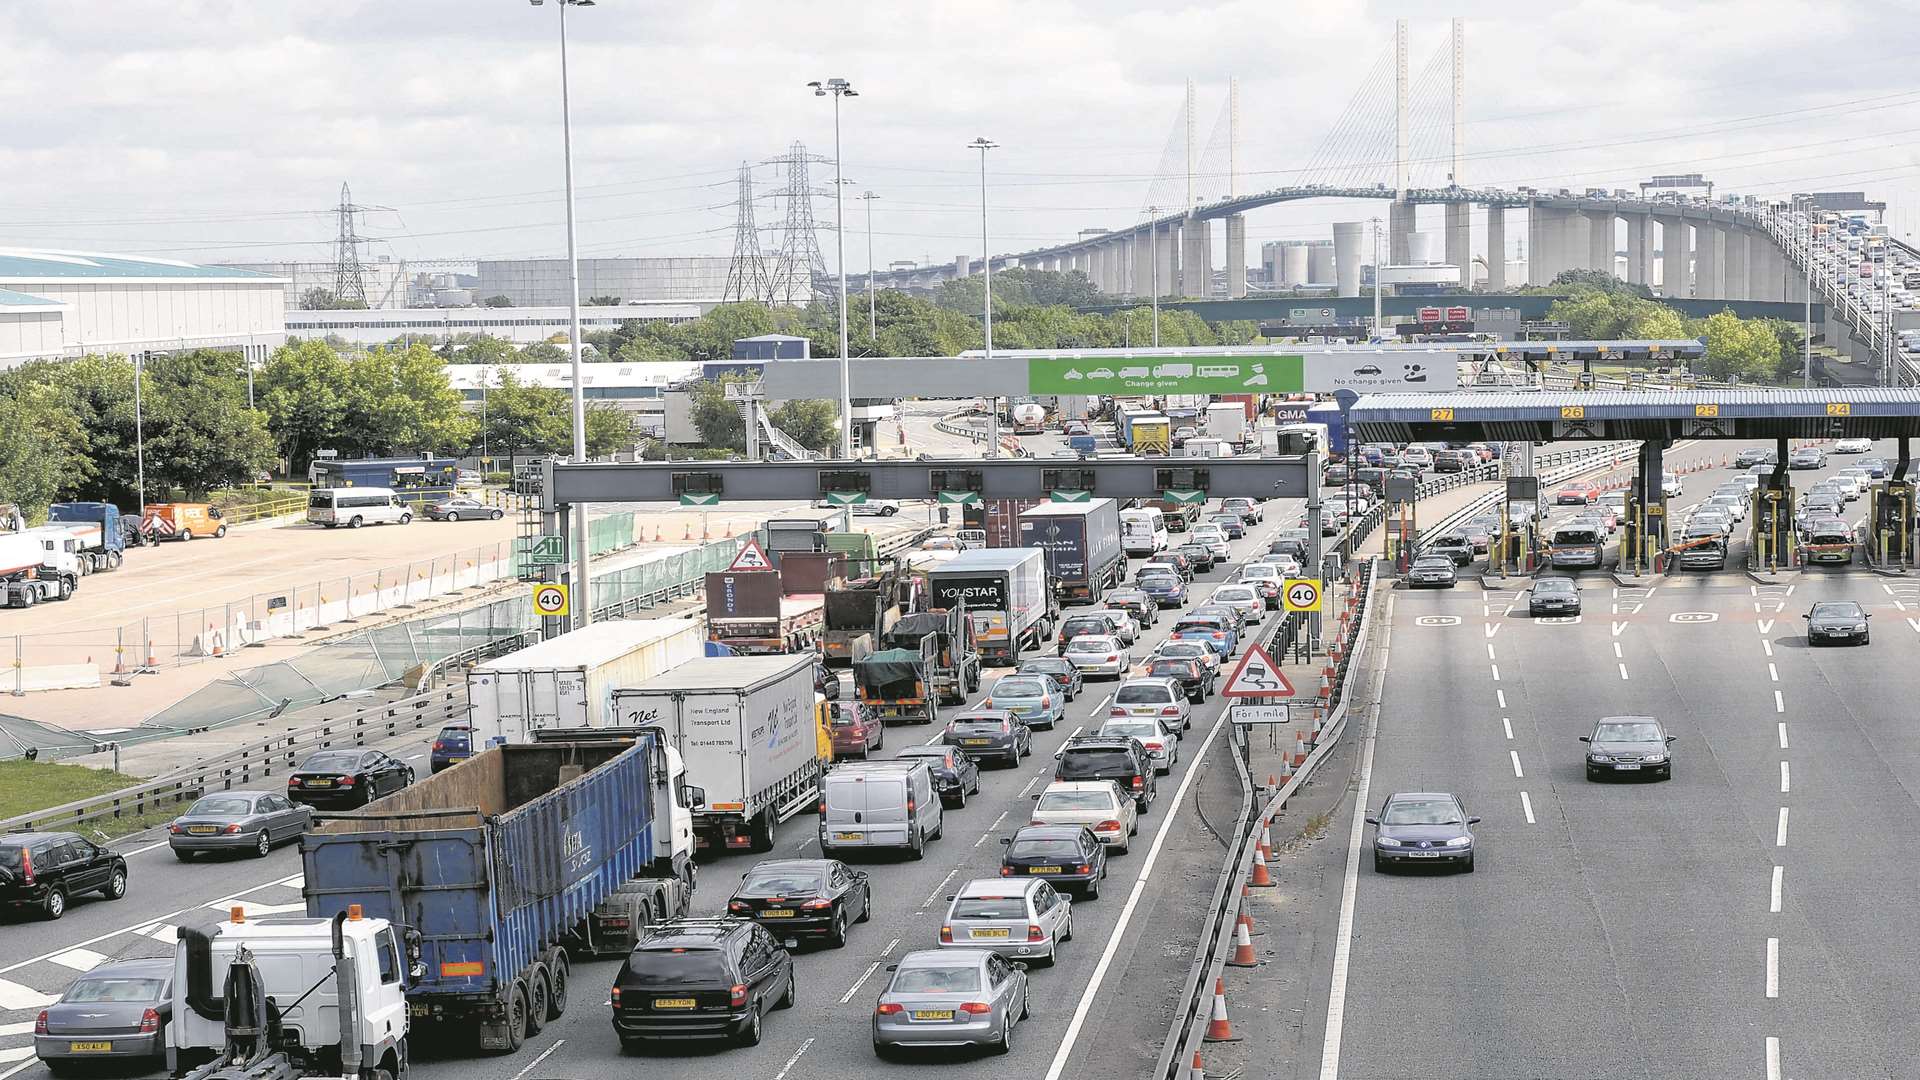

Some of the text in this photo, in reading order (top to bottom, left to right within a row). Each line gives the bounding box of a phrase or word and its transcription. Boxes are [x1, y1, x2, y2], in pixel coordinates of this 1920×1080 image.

[1125, 380, 1178, 388] Change given
[1278, 410, 1307, 420] GMA
[1434, 410, 1451, 419] 27
[1563, 408, 1582, 417] 26
[1698, 406, 1717, 416] 25
[1829, 405, 1848, 415] 24
[941, 587, 998, 598] YOUSTAR
[1291, 589, 1314, 601] 40
[541, 594, 562, 606] 40
[628, 708, 658, 724] Net
[1236, 709, 1252, 718] For
[1263, 708, 1284, 718] mile
